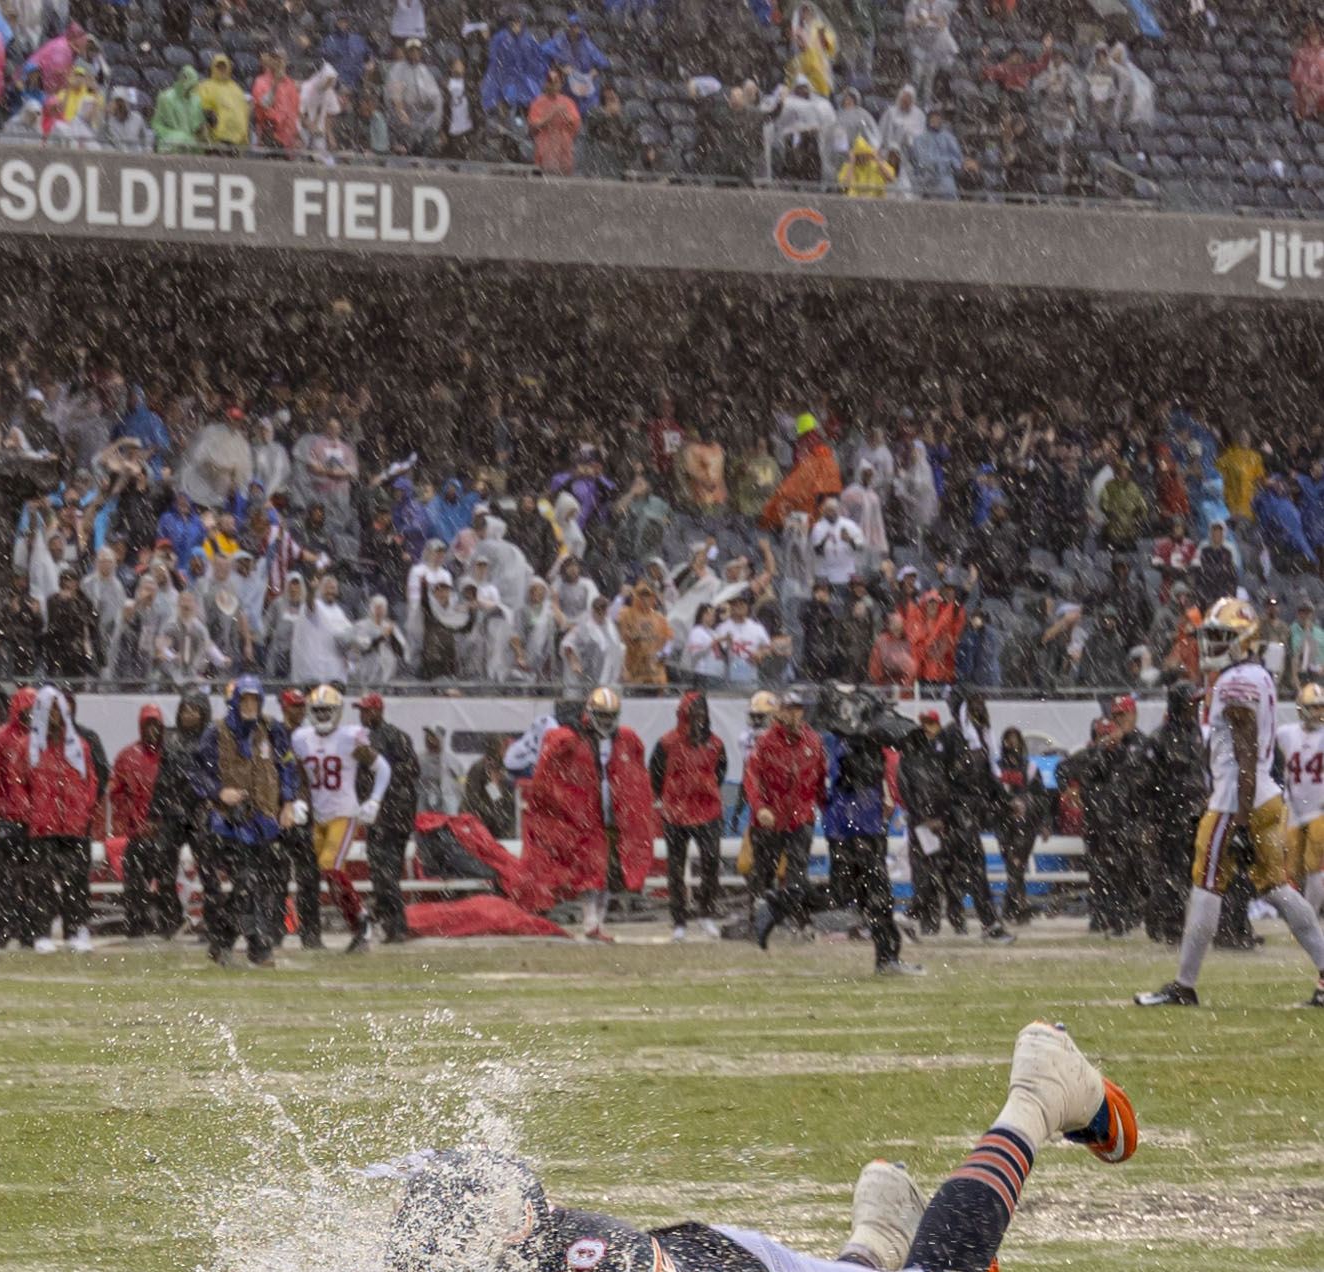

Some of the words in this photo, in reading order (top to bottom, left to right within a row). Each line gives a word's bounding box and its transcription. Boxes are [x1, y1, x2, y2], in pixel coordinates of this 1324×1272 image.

[0, 160, 256, 234] SOLDIER
[293, 178, 451, 244] FIELD
[1256, 228, 1324, 290] Lite
[1286, 752, 1324, 784] 44
